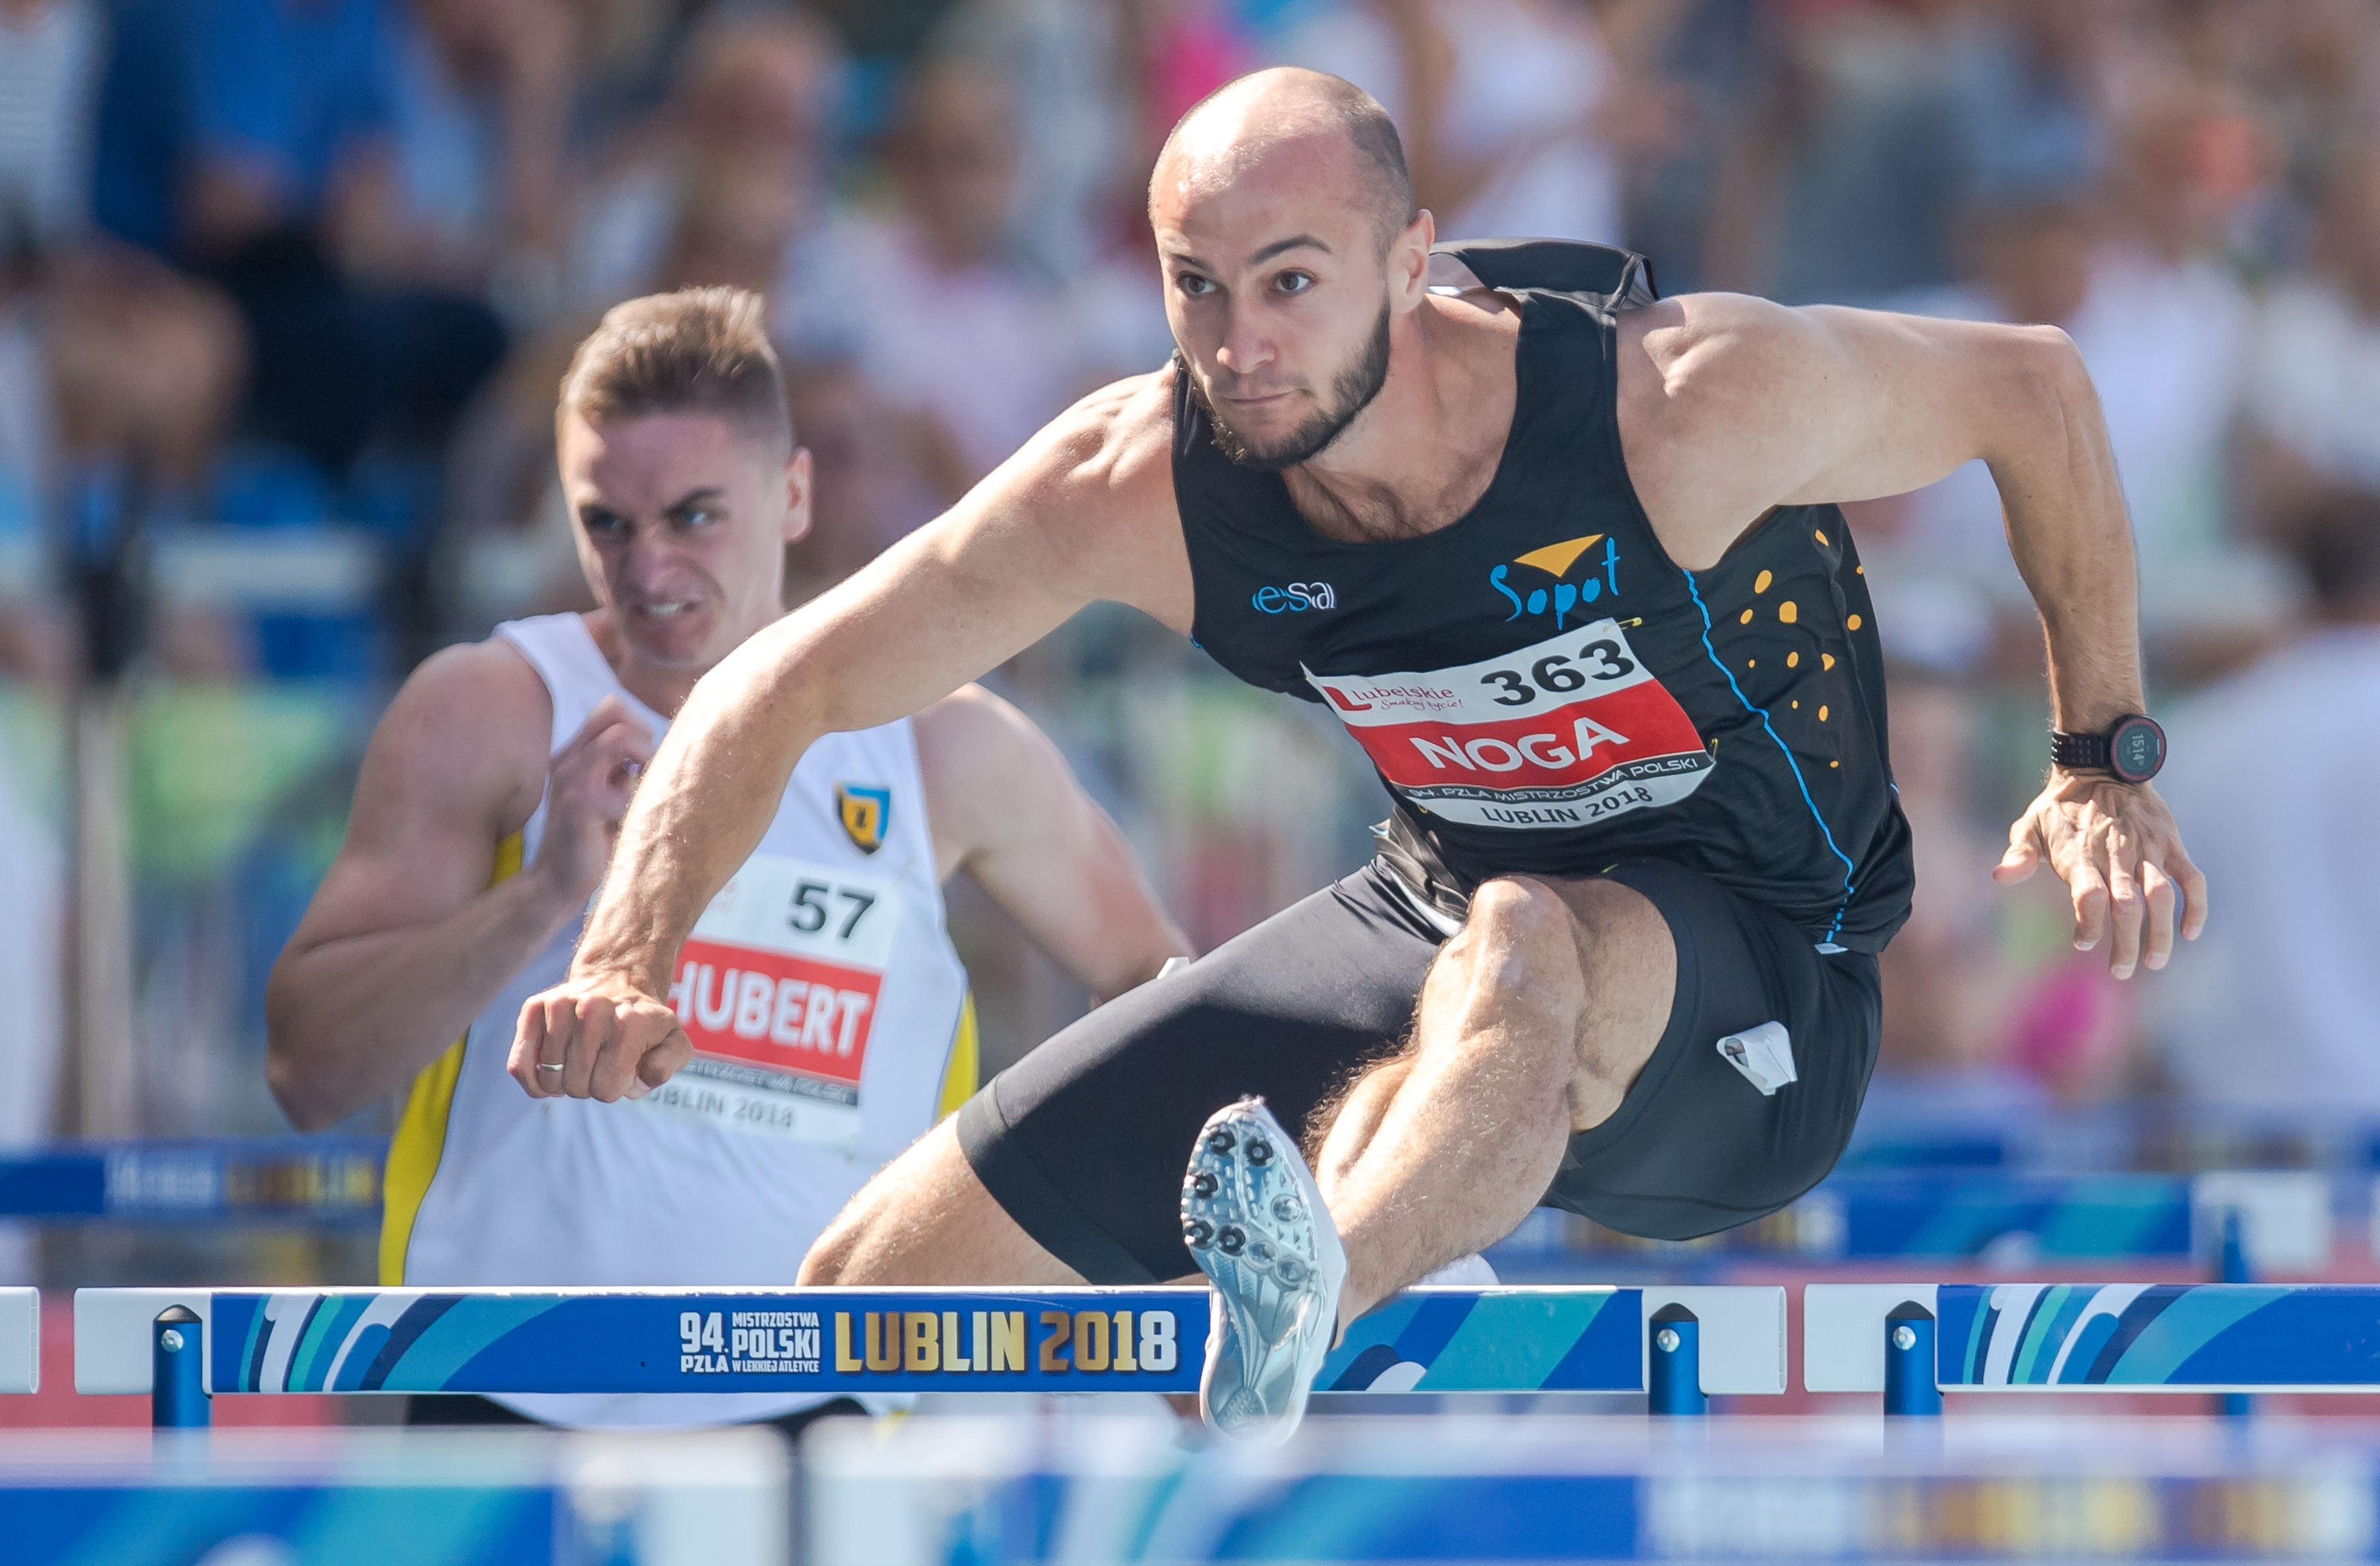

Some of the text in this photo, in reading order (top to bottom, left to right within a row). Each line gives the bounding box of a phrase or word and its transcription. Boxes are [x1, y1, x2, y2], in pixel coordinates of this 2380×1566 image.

[1490, 537, 1621, 630] Sopot
[1480, 639, 1635, 707] 363
[1409, 716, 1630, 773] NOGA
[1441, 788, 1492, 799] PZLA
[1494, 769, 1629, 801] MISTRZOSTWA
[1630, 757, 1699, 777] POLSKI
[1480, 786, 1654, 825] LUBLIN 2018
[789, 875, 876, 942] 57
[680, 1311, 729, 1353] 94.
[732, 1311, 819, 1328] MISTRZOSTWA
[732, 1328, 820, 1359] POLSKI
[834, 1310, 1178, 1373] LUBLIN 2018
[681, 1354, 729, 1373] PZLA
[732, 1360, 819, 1373] W LEKKIEJ ATLETYCE
